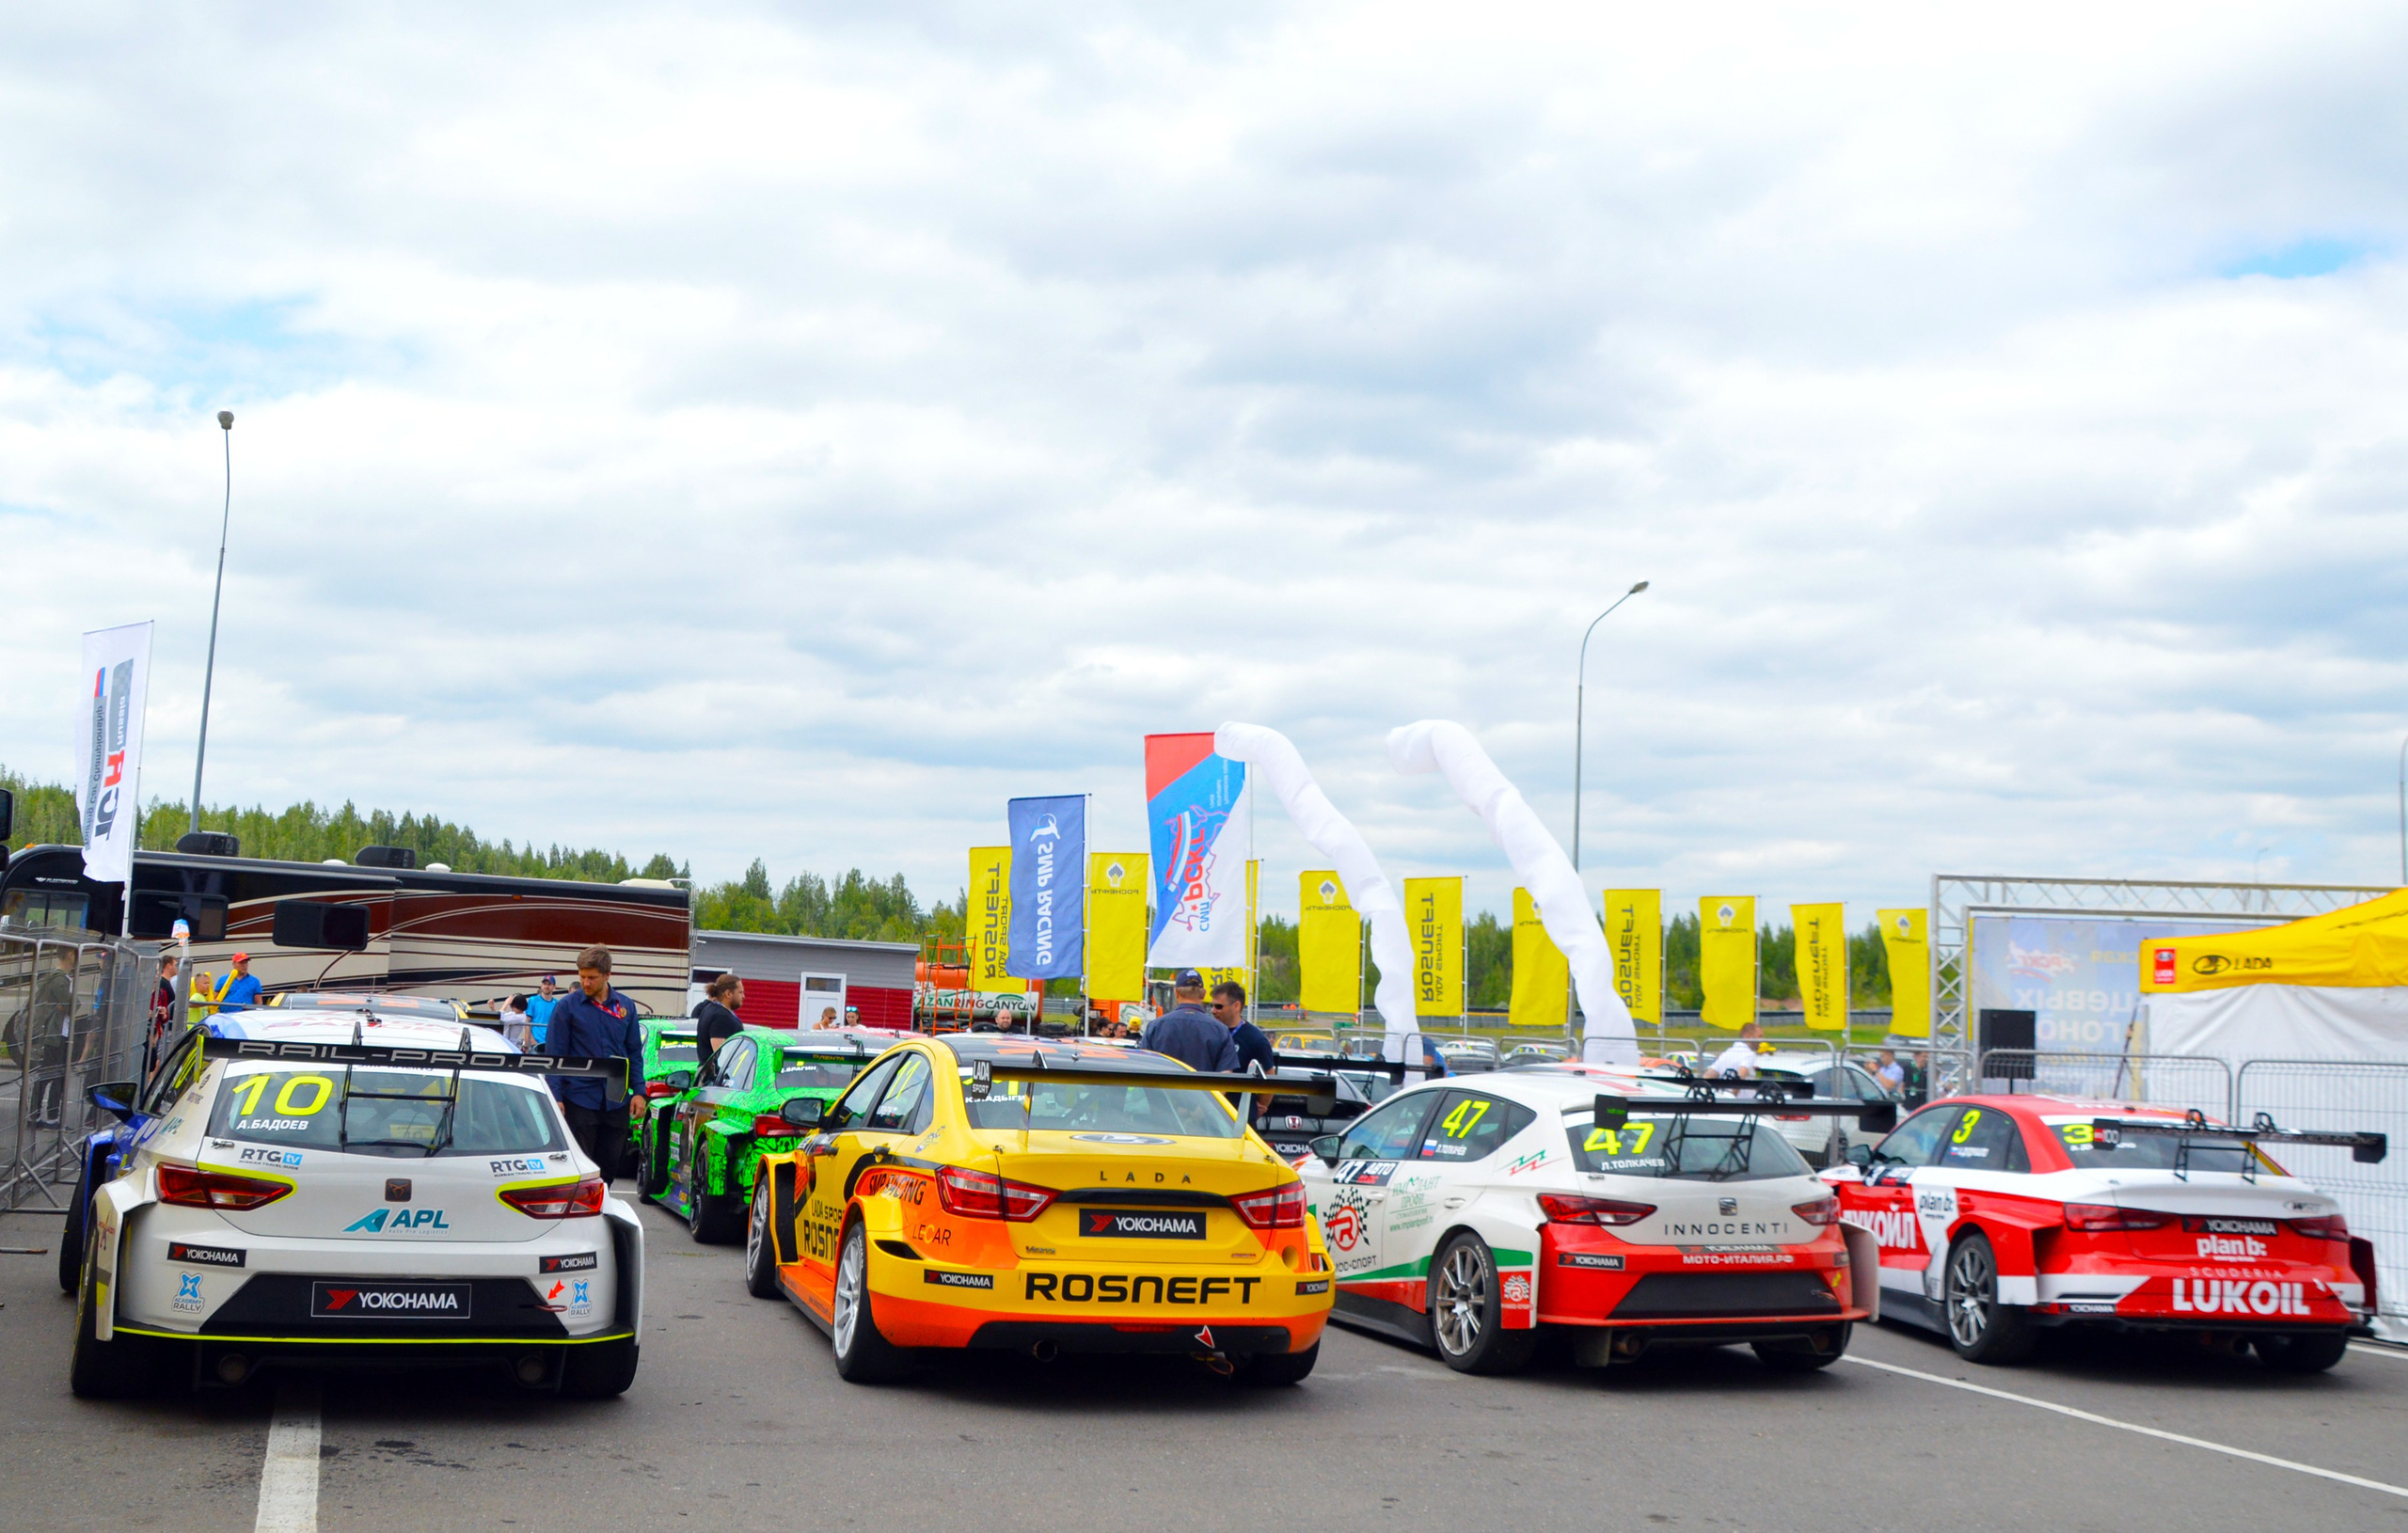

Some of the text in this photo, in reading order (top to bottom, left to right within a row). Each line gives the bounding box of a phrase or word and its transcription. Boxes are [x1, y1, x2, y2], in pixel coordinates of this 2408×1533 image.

[2234, 957, 2273, 971] LADA
[238, 1041, 593, 1070] RAIL-PRO.RU
[974, 1061, 990, 1082] LADA
[232, 1075, 333, 1116] 10
[972, 1083, 989, 1094] SPORT
[236, 1118, 309, 1131] А.БАДОЕВ
[1441, 1099, 1491, 1139] 47
[1952, 1109, 1982, 1144] 3
[1583, 1122, 1654, 1155] 47
[2062, 1123, 2094, 1145] 3
[240, 1148, 301, 1165] RTG tv
[489, 1160, 543, 1173] RTG tv
[1335, 1161, 1366, 1183] 47
[1363, 1162, 1397, 1176] АВТО
[1101, 1171, 1192, 1184] LADA
[812, 1199, 823, 1218] LADA
[1919, 1192, 1942, 1213] plan
[389, 1209, 450, 1228] APL
[1116, 1217, 1196, 1233] YOKOHAMA
[1664, 1223, 1787, 1236] INNOCENTI
[2205, 1219, 2277, 1235] YOKOHAMA
[2196, 1235, 2244, 1257] plan
[186, 1248, 238, 1264] YOKOHAMA
[560, 1256, 594, 1269] YOKOHAMA
[1575, 1256, 1619, 1267] YOKOHAMA
[1683, 1255, 1794, 1265] МОТО-ИТАЛИЯ.РФ
[940, 1273, 990, 1287] YOKOHAMA
[2190, 1267, 2285, 1279] SCUDERIA
[1025, 1272, 1261, 1304] ROSNEFT
[358, 1292, 459, 1309] YOKOHAMA
[2173, 1278, 2311, 1315] LUKOIL
[173, 1303, 201, 1312] RALLY
